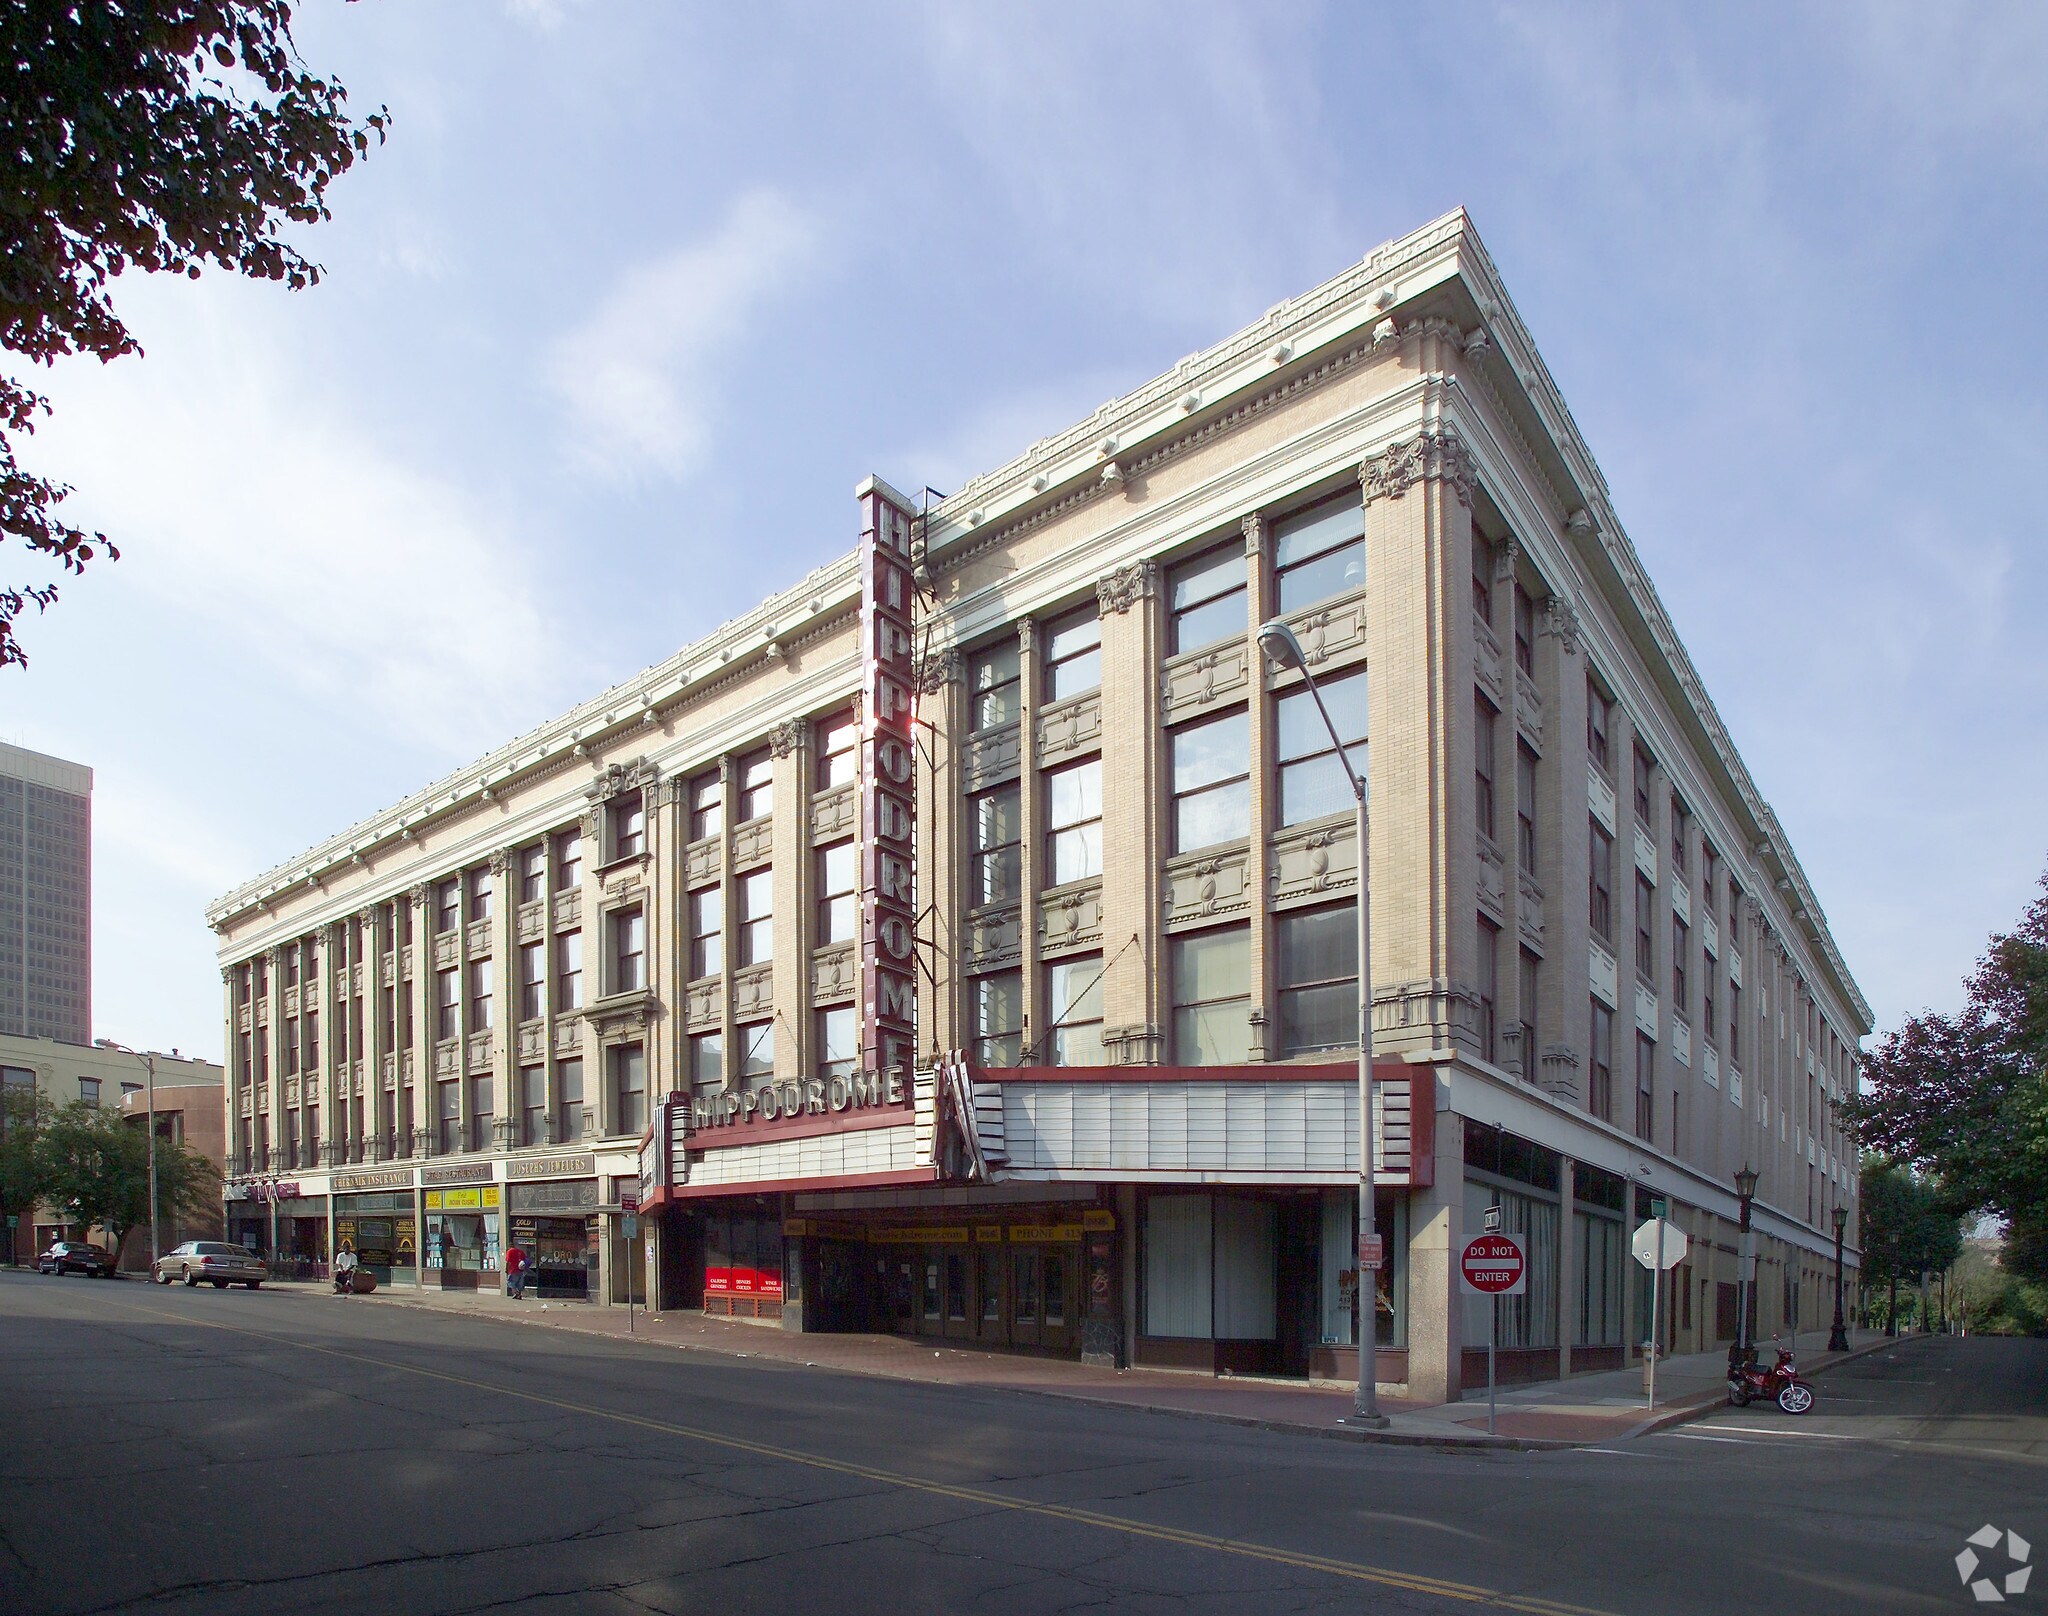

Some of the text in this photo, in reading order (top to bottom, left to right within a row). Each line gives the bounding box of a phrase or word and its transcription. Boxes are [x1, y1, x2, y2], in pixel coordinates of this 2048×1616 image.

[879, 500, 913, 1080] HIPPODROME
[692, 1065, 905, 1129] HIPPODROME
[445, 1166, 486, 1179] RESTAURANT
[513, 1158, 586, 1175] JOSEPH'S JEWELERS
[368, 1172, 407, 1185] INSURANCE
[1016, 1228, 1055, 1239] PHONE
[1470, 1246, 1514, 1256] DO NOT
[1474, 1272, 1511, 1283] ENTER
